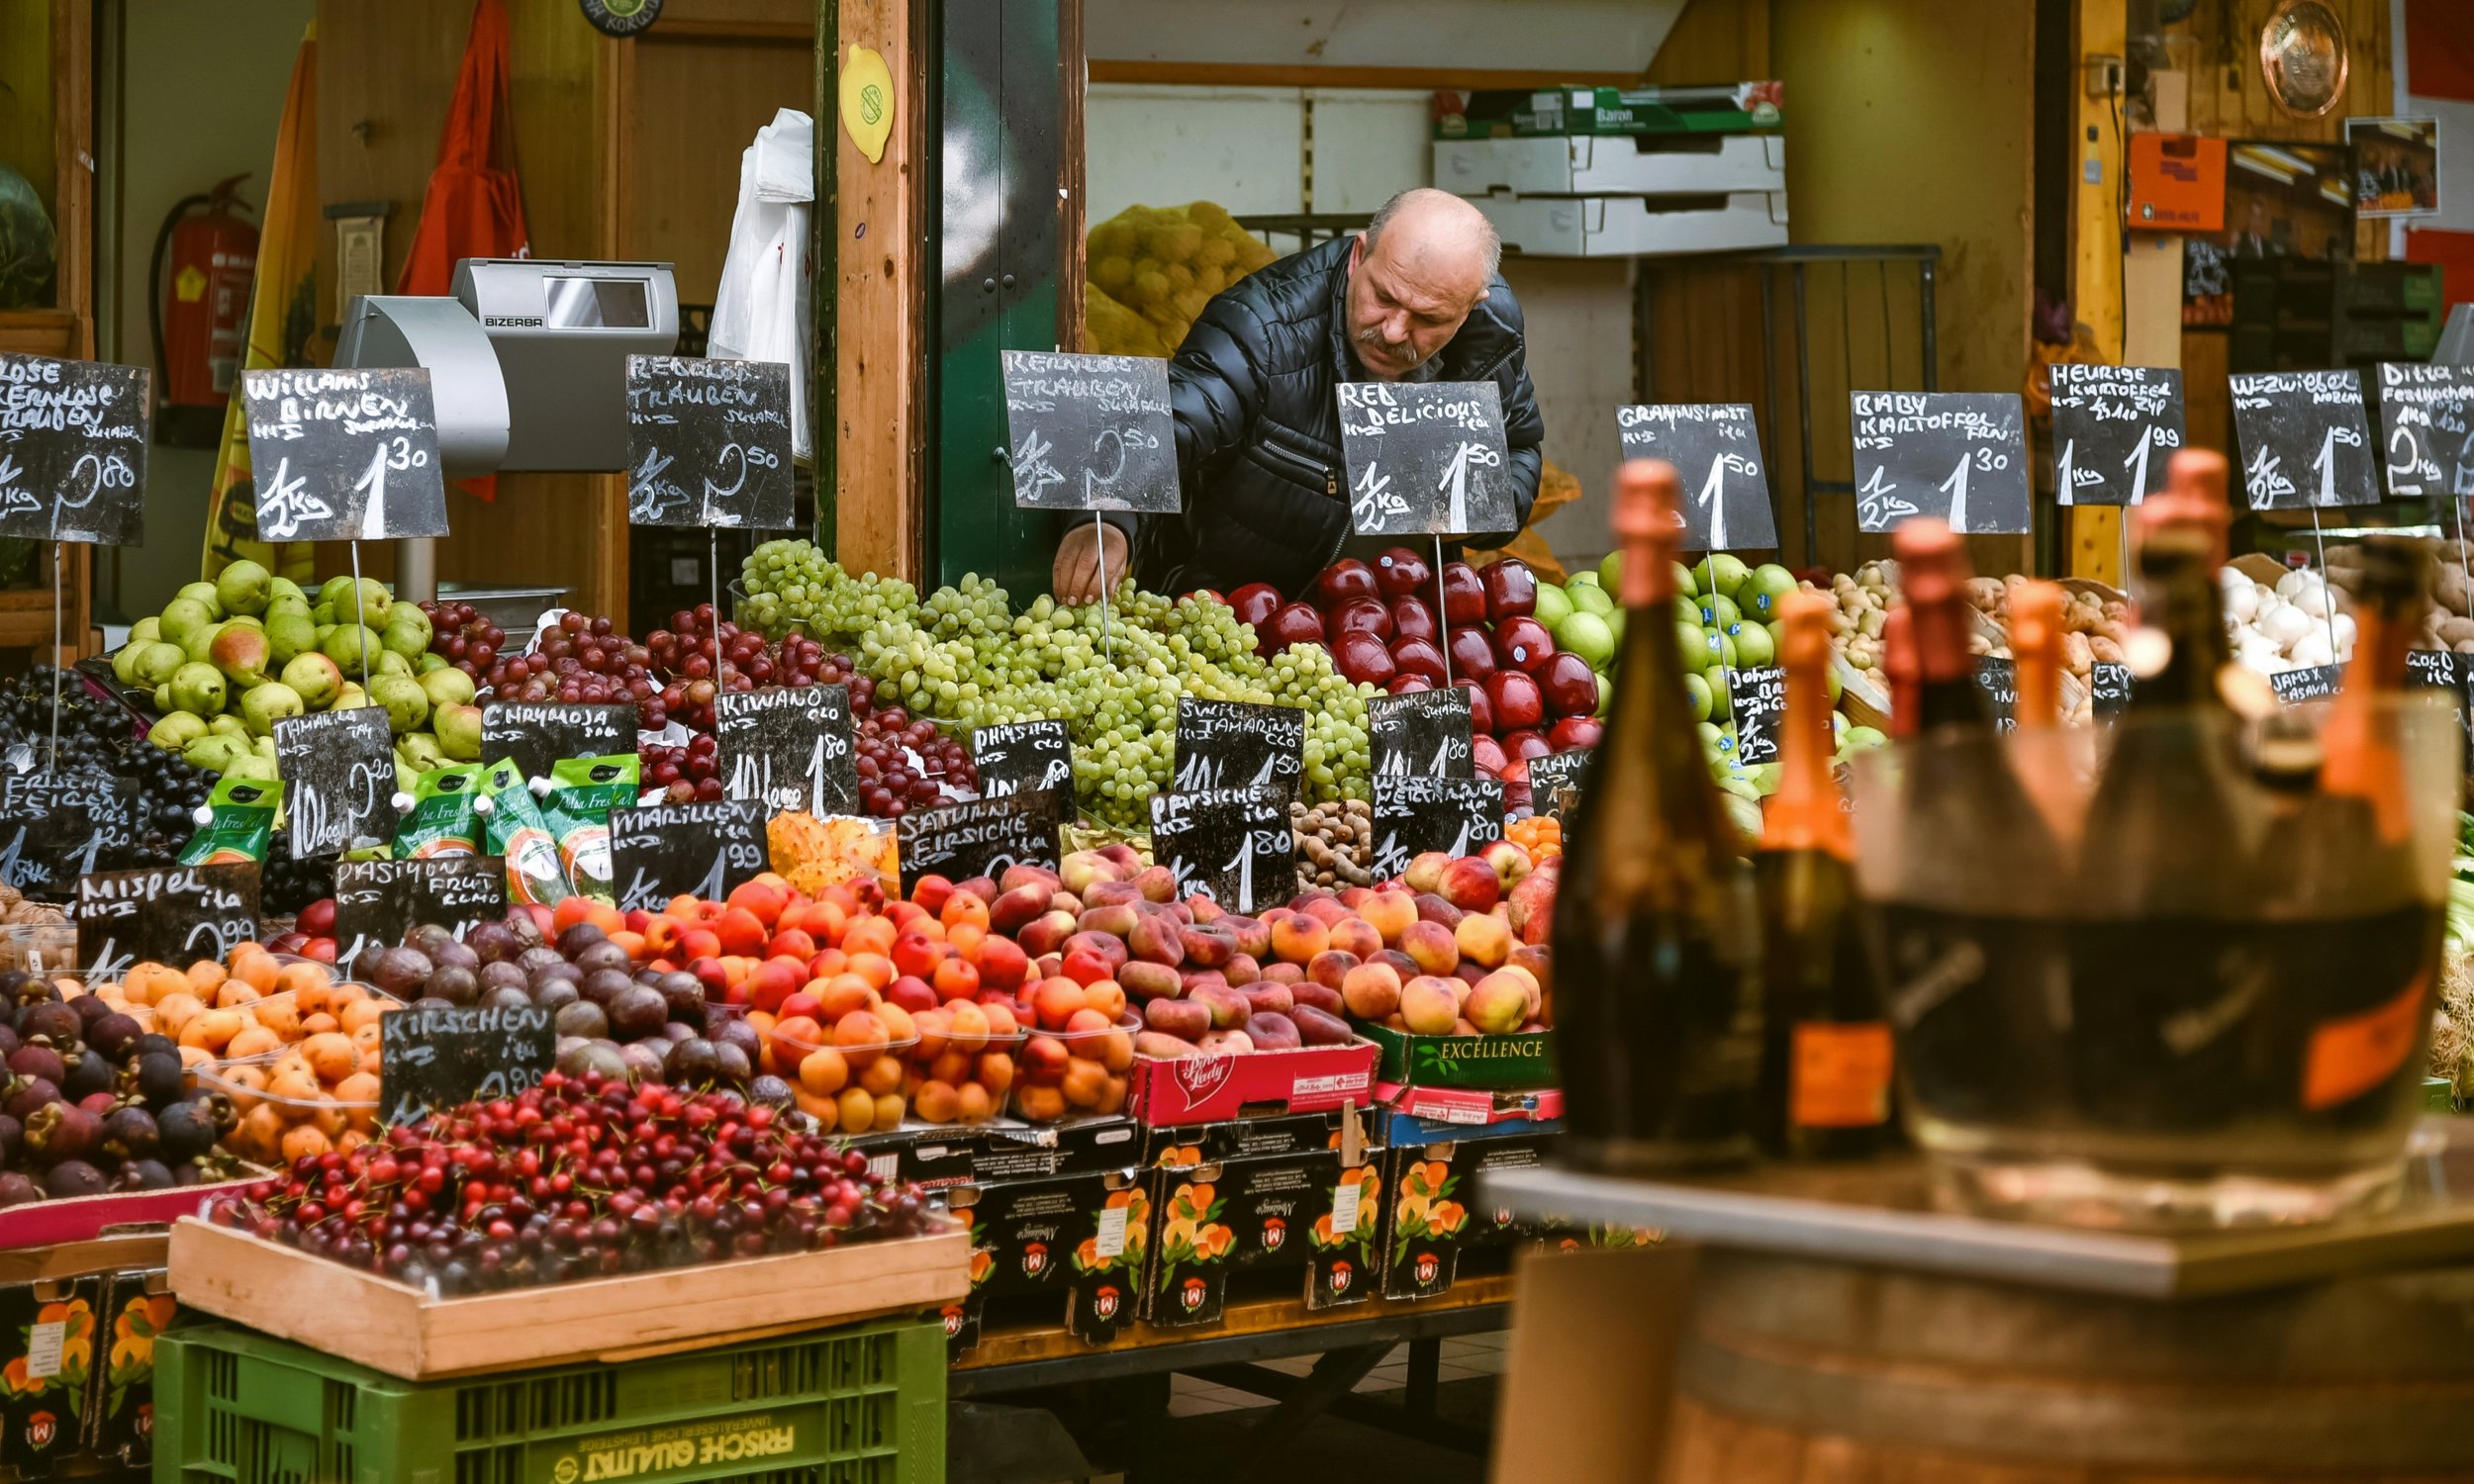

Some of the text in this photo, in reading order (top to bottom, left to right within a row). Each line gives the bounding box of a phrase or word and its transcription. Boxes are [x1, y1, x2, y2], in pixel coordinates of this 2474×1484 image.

[1596, 107, 1633, 123] Baron
[485, 318, 543, 327] BIZERBA
[1339, 382, 1397, 408] RED
[1855, 394, 1928, 417] BABY
[898, 802, 1008, 841] SATURN
[384, 1007, 547, 1042] KIRSCHEN
[1442, 1041, 1544, 1060] EXCELLENCE
[1189, 1064, 1224, 1091] Lady
[699, 1426, 795, 1464] FRISCHE
